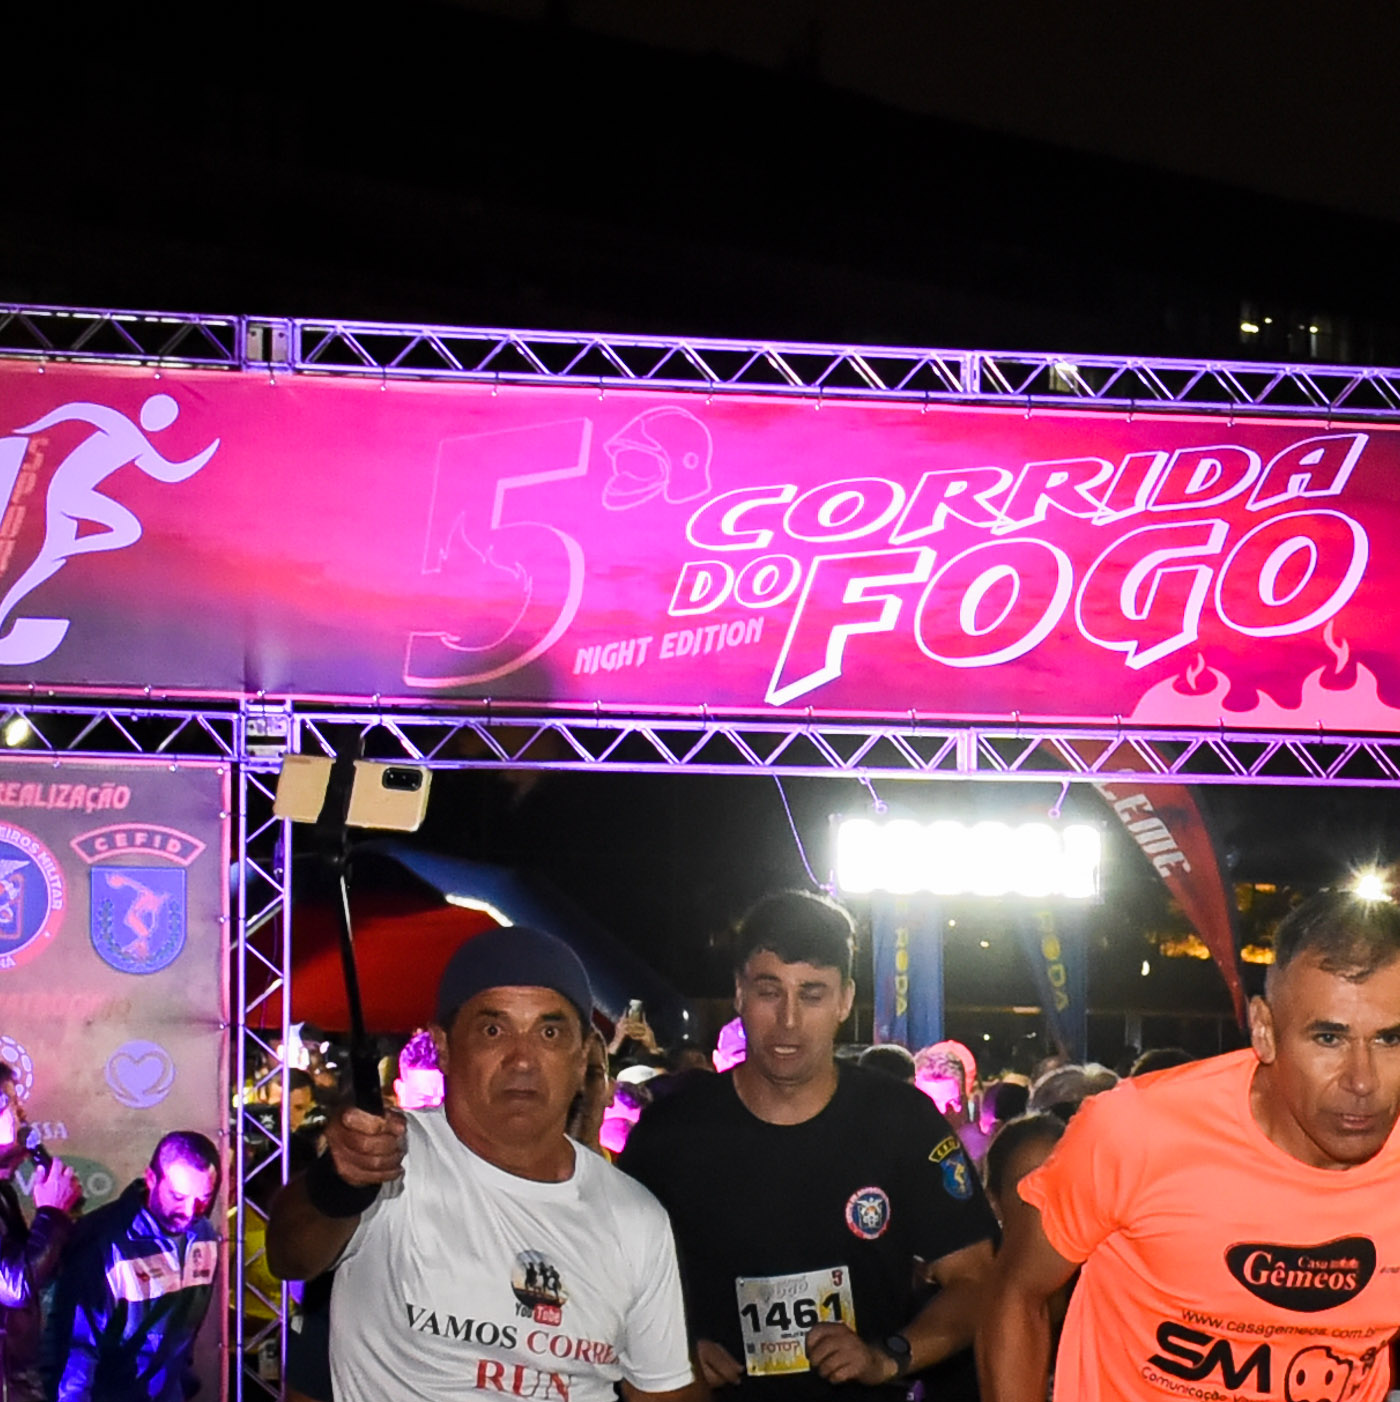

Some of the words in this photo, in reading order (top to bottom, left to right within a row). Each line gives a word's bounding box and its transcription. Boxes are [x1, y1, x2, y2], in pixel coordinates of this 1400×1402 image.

[687, 433, 1369, 551] CORRIDA
[669, 554, 802, 617] DO
[764, 508, 1369, 706] FOGO
[574, 635, 653, 676] NIGHT
[659, 617, 764, 659] EDITION
[94, 831, 183, 853] CEFID
[38, 850, 64, 910] MILITAR
[1243, 1250, 1357, 1291] Gêmeos
[1297, 1255, 1328, 1269] Casa
[406, 1303, 518, 1350] VAMOS
[741, 1293, 842, 1333] 1461
[1147, 1321, 1272, 1394] SM
